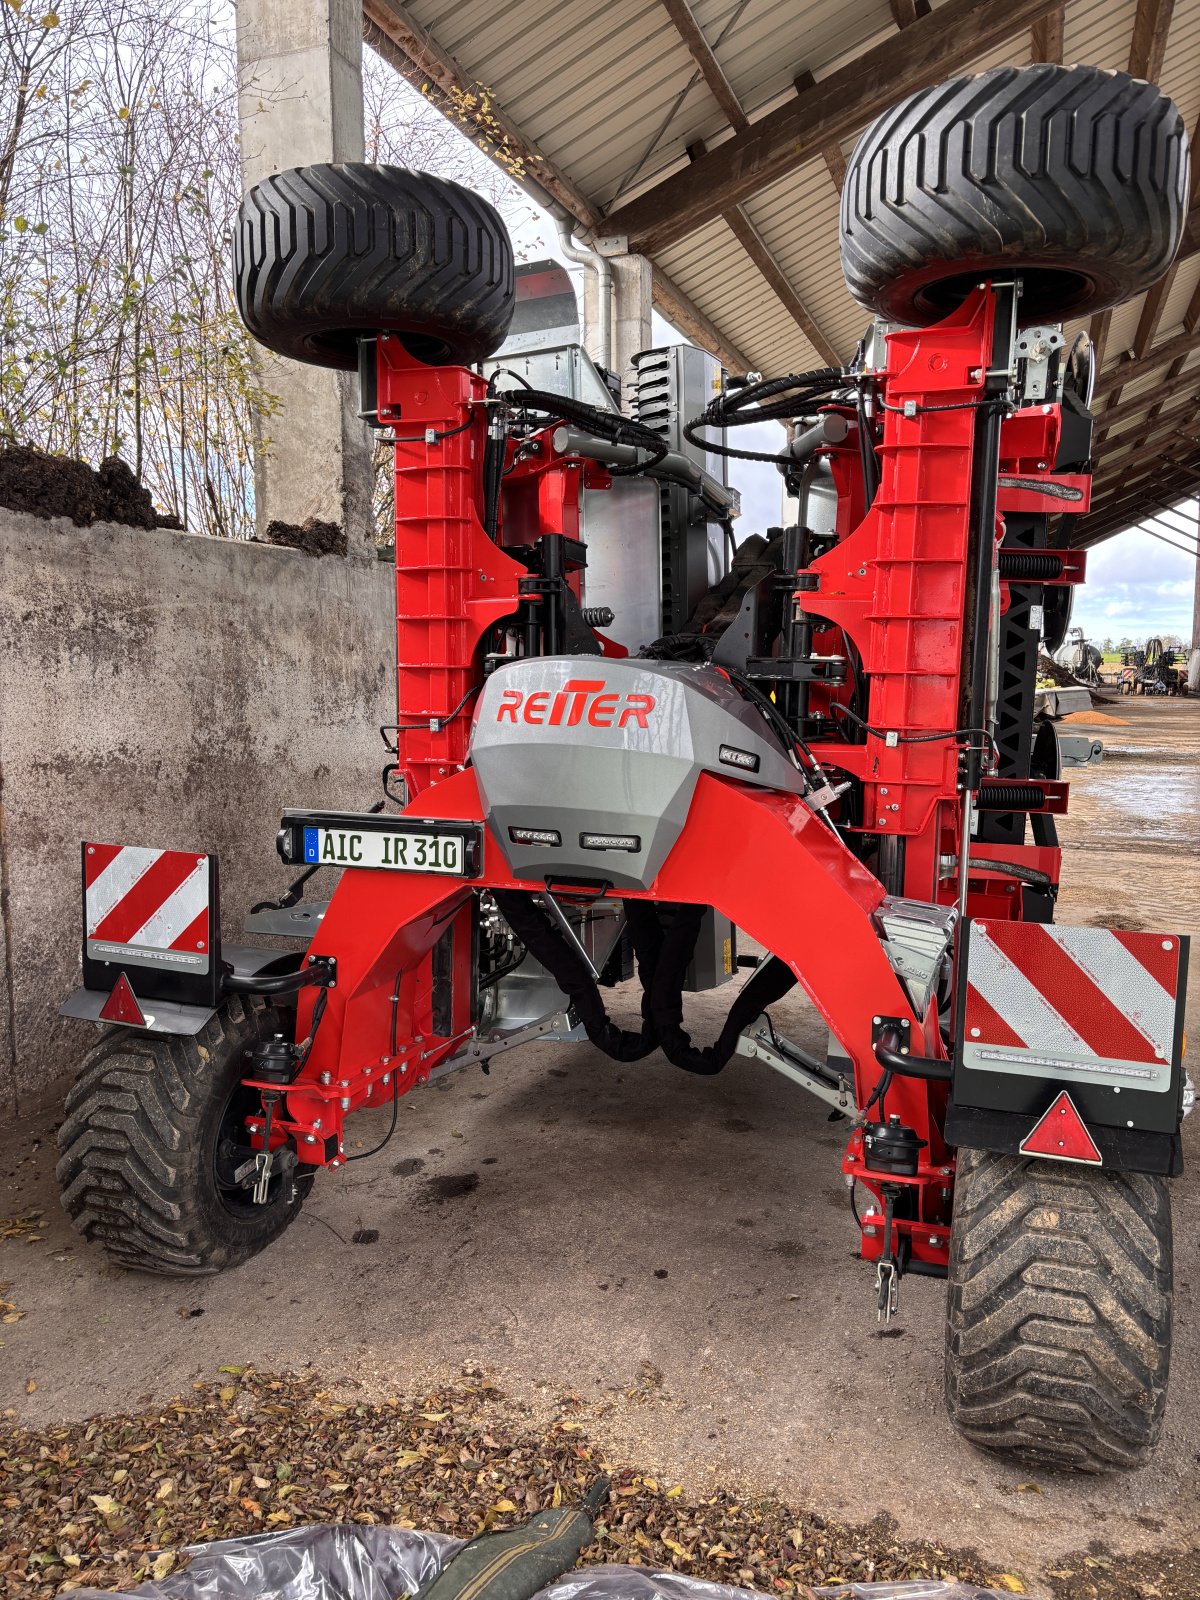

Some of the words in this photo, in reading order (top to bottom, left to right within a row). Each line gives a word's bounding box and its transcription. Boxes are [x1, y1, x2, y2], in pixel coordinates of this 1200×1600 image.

[496, 679, 656, 729] REITER
[309, 848, 315, 857] D
[322, 833, 363, 862] AIC
[381, 837, 408, 866] IR
[413, 838, 457, 869] 310
